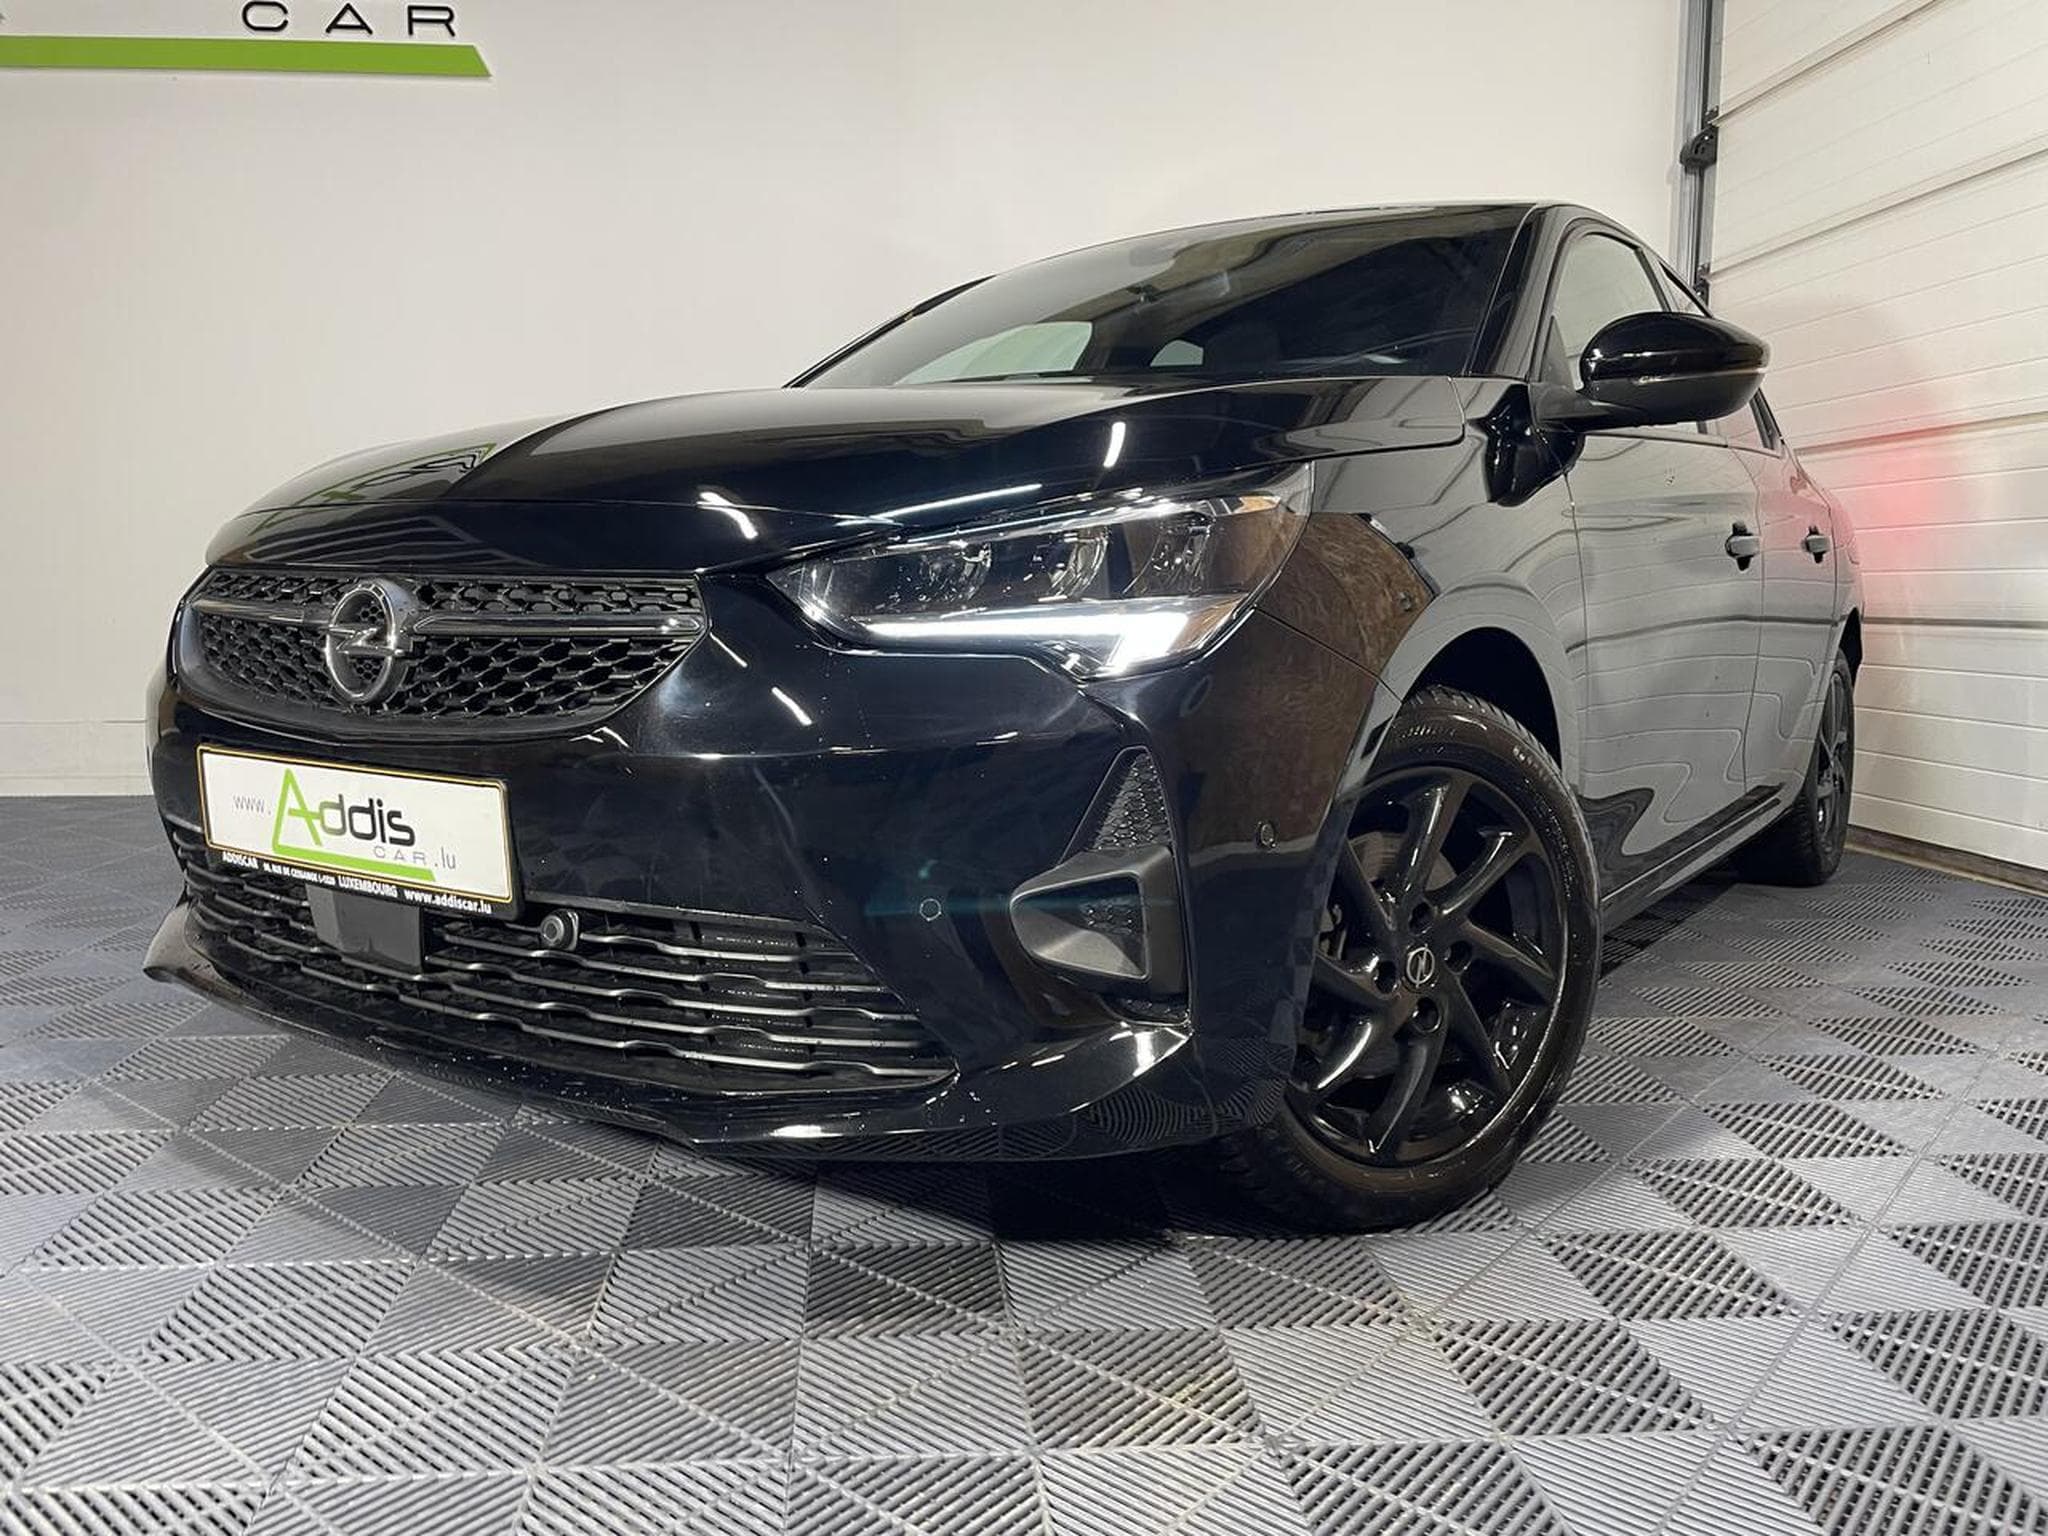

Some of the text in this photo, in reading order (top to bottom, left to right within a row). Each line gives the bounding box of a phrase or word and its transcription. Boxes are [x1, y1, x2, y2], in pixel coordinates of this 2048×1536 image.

[242, 1, 455, 37] CAR
[272, 768, 415, 850] Addis
[338, 875, 398, 898] LUXEMBOURG
[404, 889, 492, 914] www.addiscar.lu
